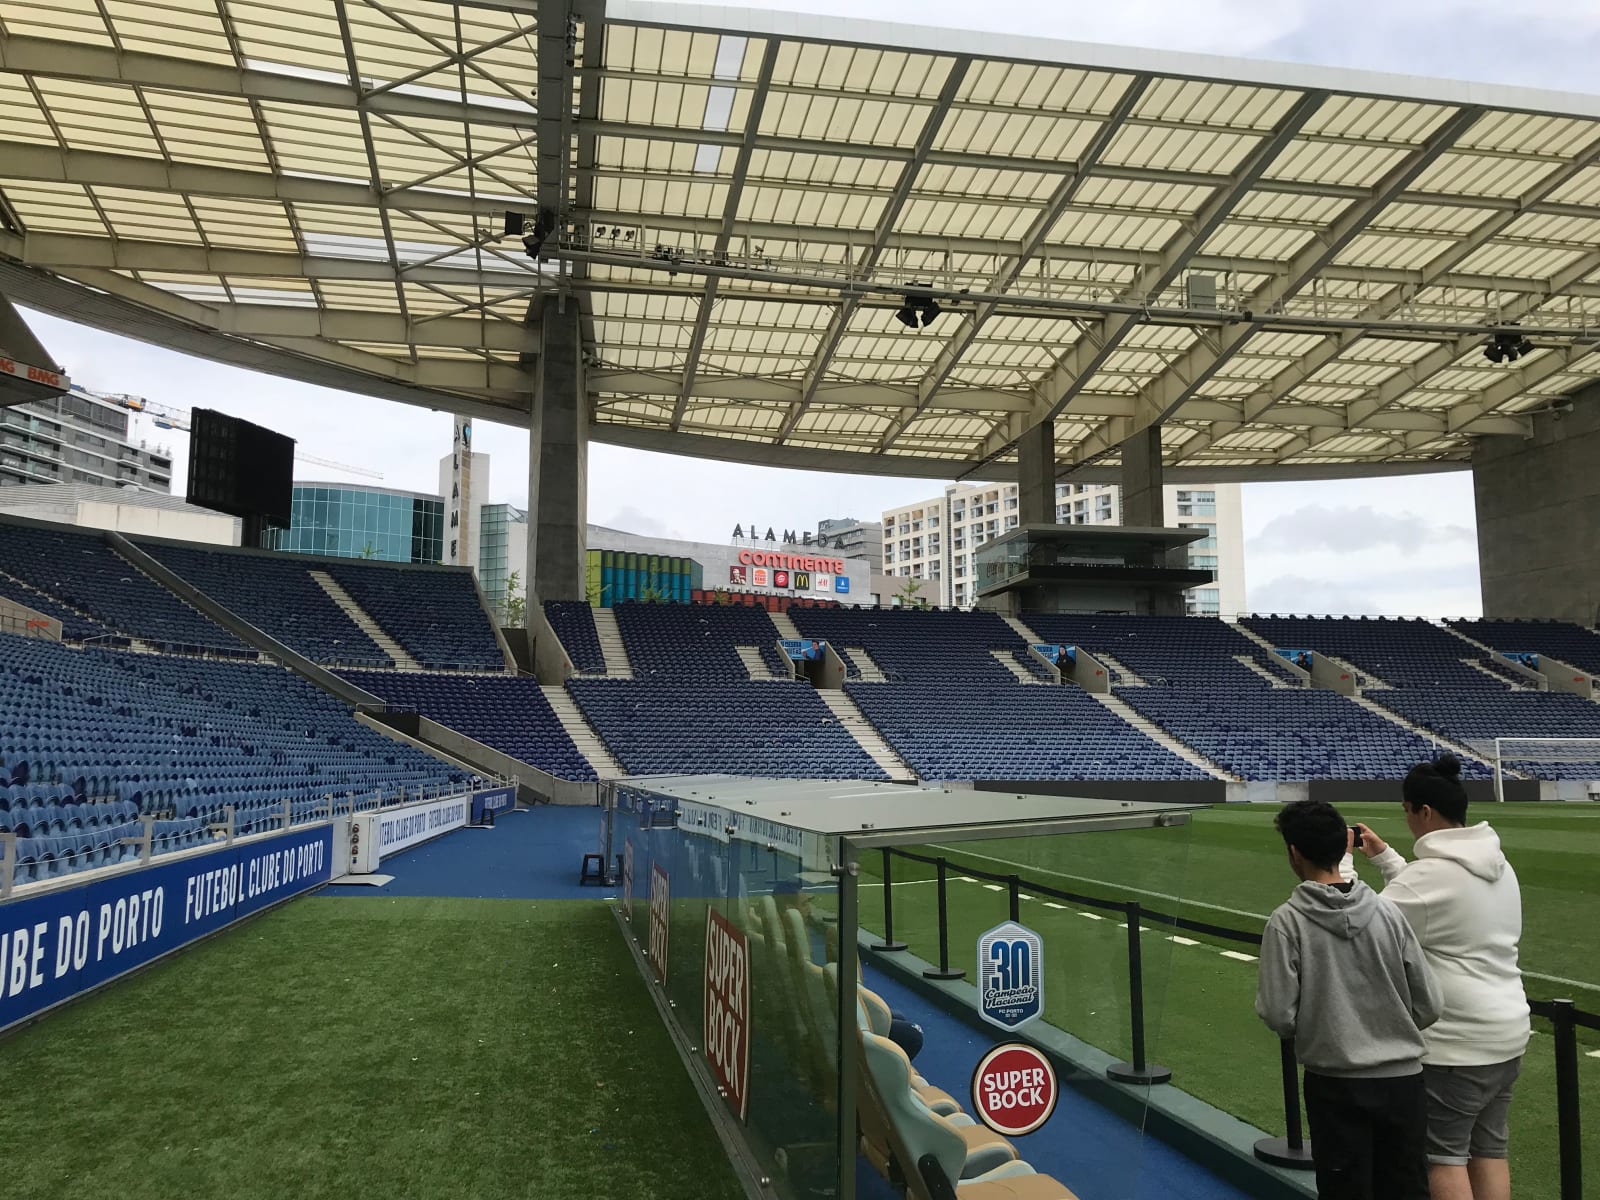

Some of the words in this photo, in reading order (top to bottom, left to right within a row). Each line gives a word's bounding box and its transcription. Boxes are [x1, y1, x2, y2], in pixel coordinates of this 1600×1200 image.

[28, 367, 60, 386] BMG
[732, 523, 845, 549] ALAMEDA
[396, 817, 409, 841] CLUBE
[415, 812, 426, 835] PORTO
[185, 862, 244, 924] FUTEBOL
[248, 849, 281, 899] CLUBE
[282, 846, 296, 886] DO
[296, 839, 324, 879] PORTO
[55, 910, 90, 979] DO
[97, 886, 164, 962] PORTO
[709, 919, 743, 1020] SUPER
[991, 940, 1031, 990] 30
[986, 993, 1034, 1008] Nacional
[709, 989, 741, 1098] BOCK
[983, 1067, 1046, 1092] SUPER
[988, 1086, 1045, 1111] BOCK
